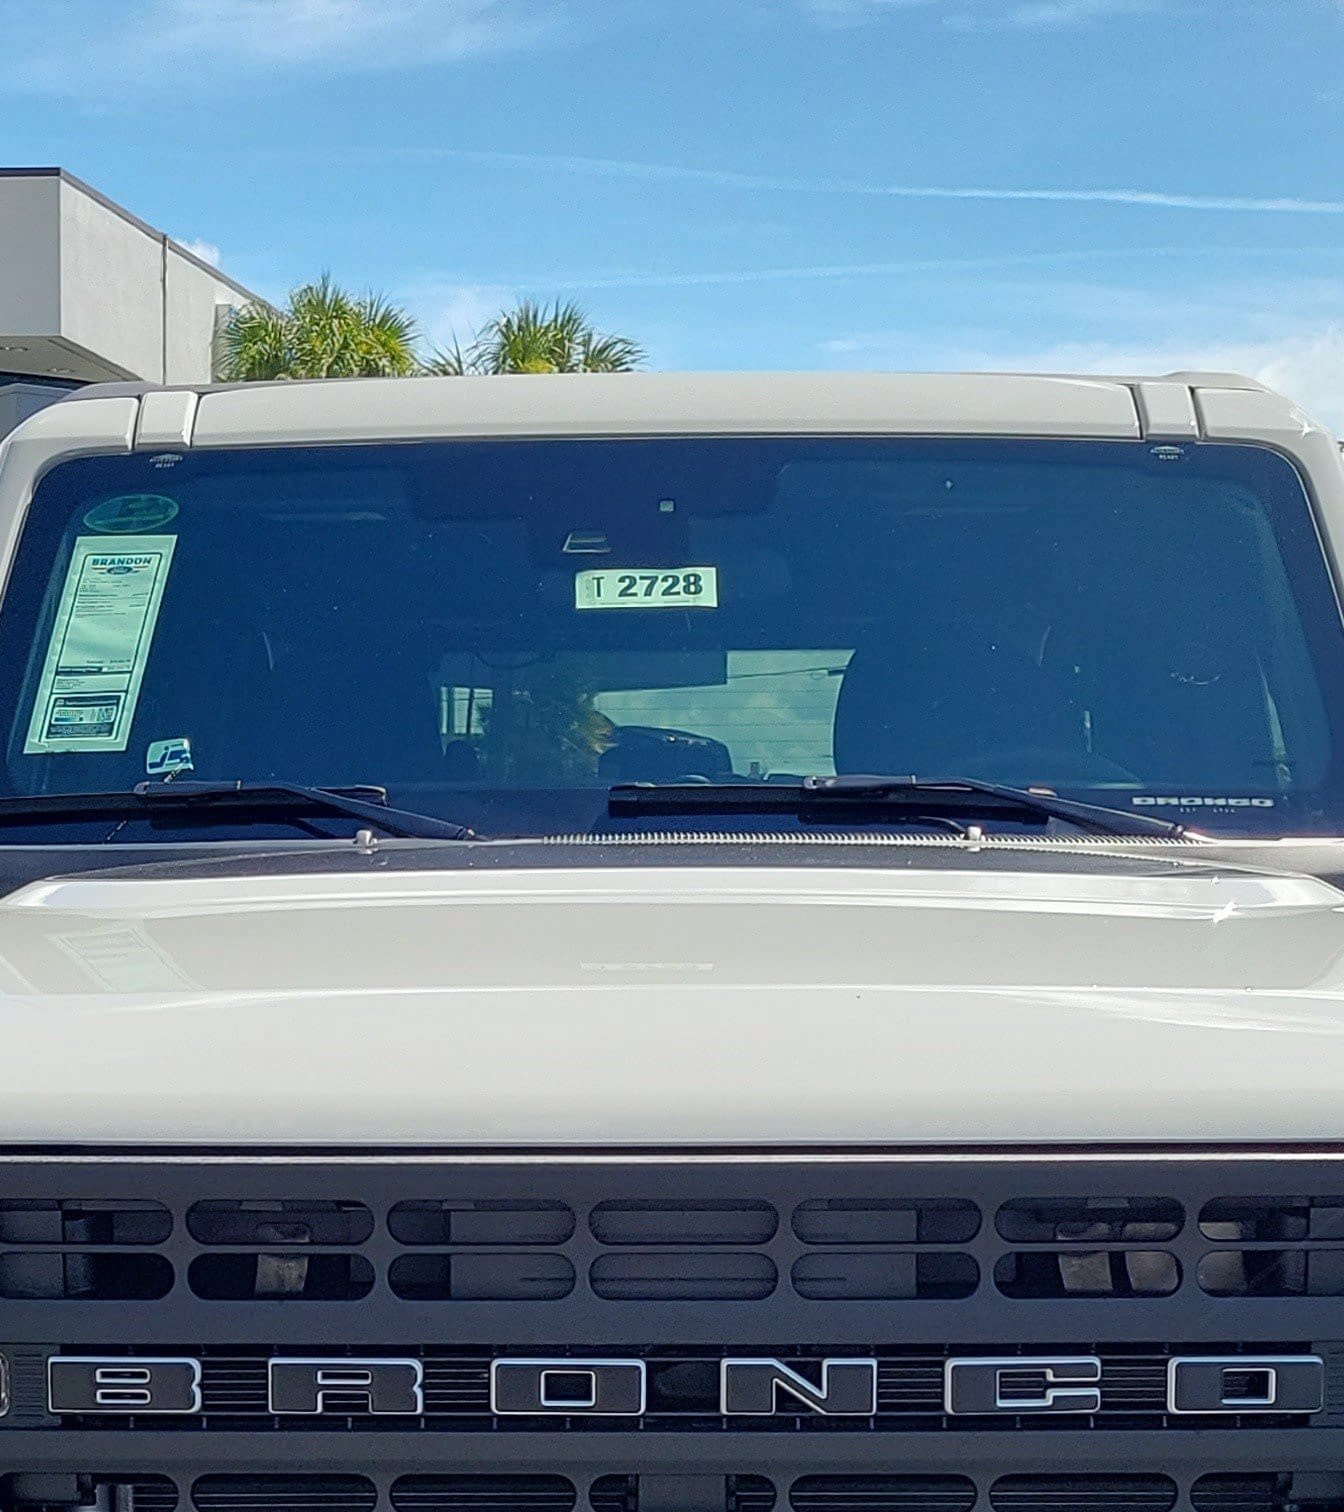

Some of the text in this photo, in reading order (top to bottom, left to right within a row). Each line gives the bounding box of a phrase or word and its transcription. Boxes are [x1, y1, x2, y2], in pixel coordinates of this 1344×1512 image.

[91, 557, 153, 566] BRANDON
[592, 573, 703, 598] T 2728
[48, 1356, 1324, 1415] BRONCO
